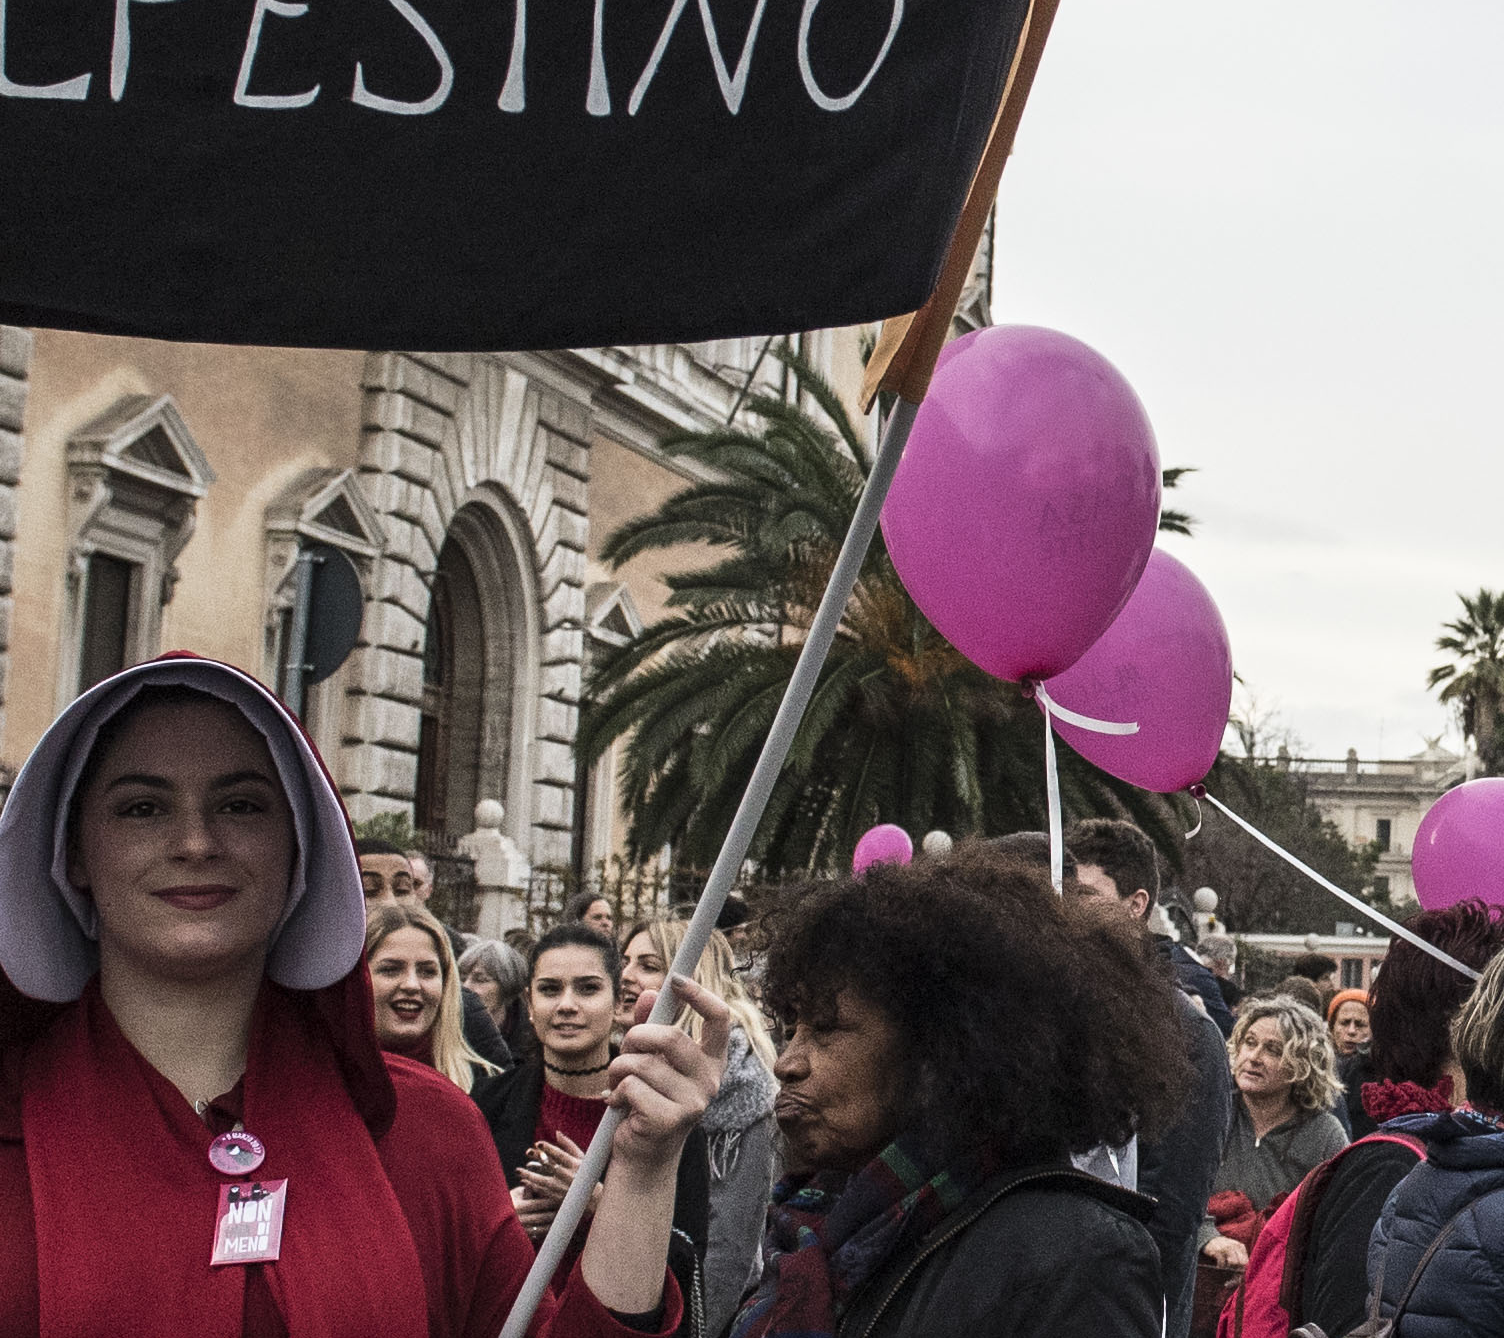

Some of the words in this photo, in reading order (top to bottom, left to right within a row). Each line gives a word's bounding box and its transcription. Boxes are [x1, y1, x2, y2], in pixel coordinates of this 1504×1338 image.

[227, 1198, 273, 1225] NON
[257, 1221, 271, 1236] DI
[223, 1235, 269, 1254] MENO
